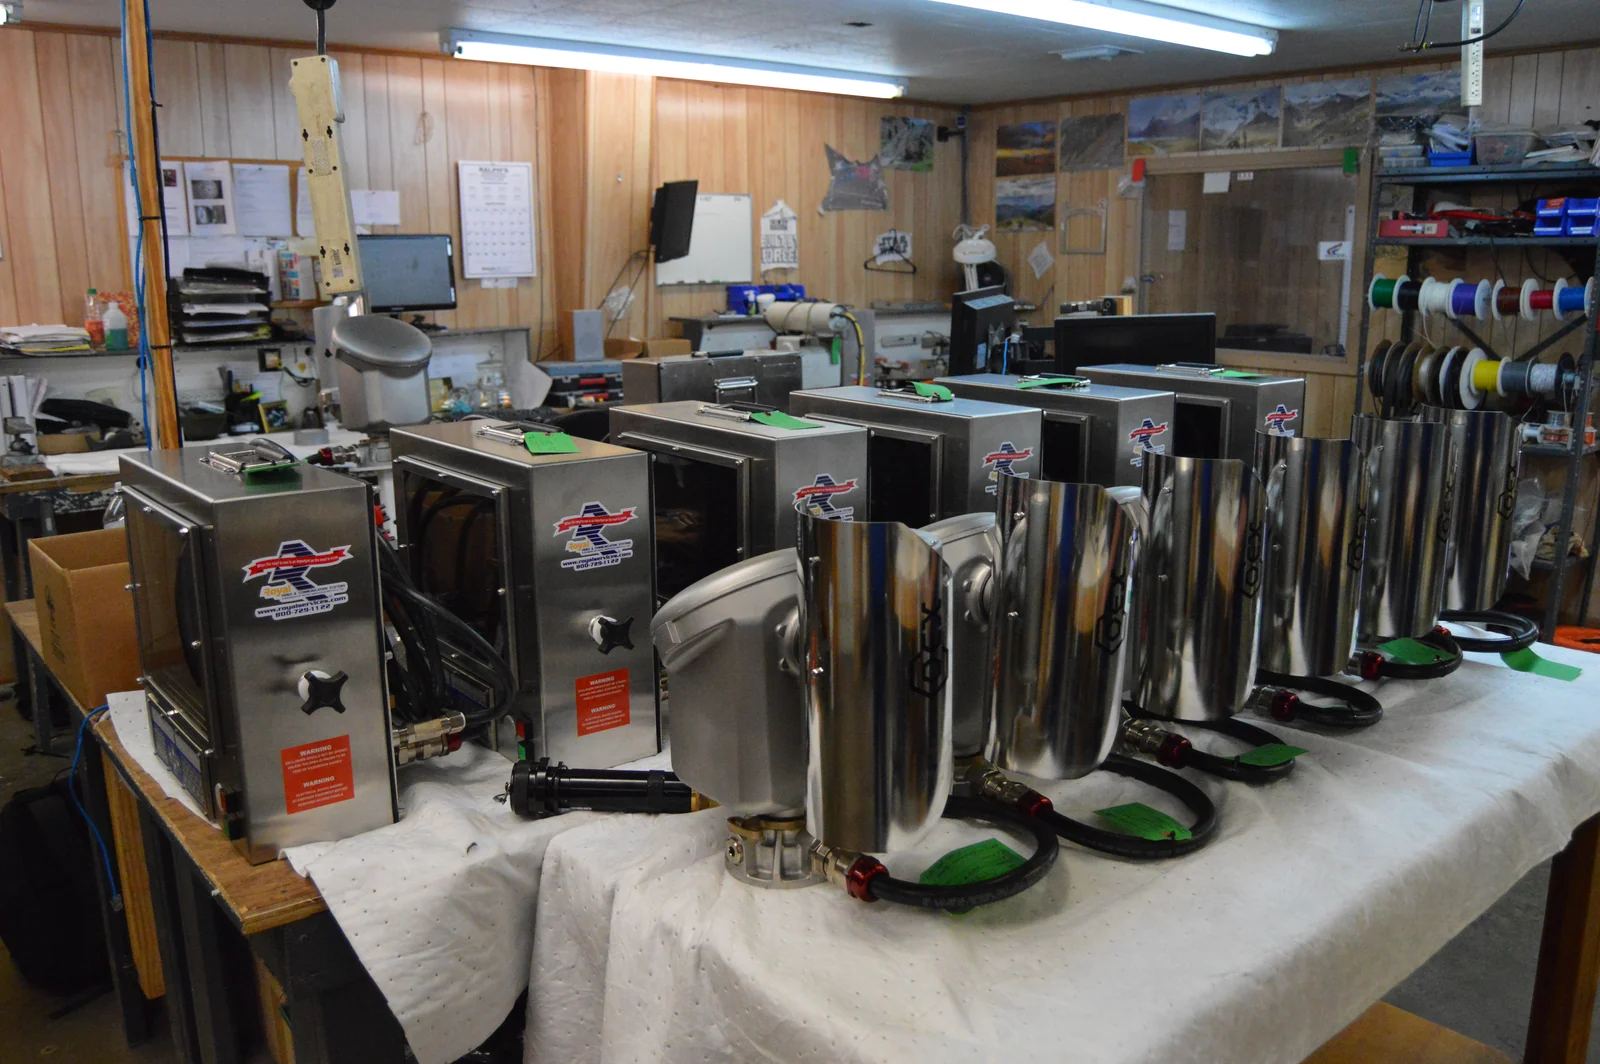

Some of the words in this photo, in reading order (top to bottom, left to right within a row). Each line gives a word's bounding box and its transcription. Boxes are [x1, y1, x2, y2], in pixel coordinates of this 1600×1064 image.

[562, 552, 632, 566] www.royalservices.com
[264, 584, 290, 597] Royal
[257, 596, 346, 615] www.royalservices.com
[275, 604, 331, 618] 800-729-1122
[590, 676, 615, 686] WARNING
[591, 704, 615, 713] WARNING
[300, 745, 332, 756] WARNING
[303, 776, 335, 788] WARNING
